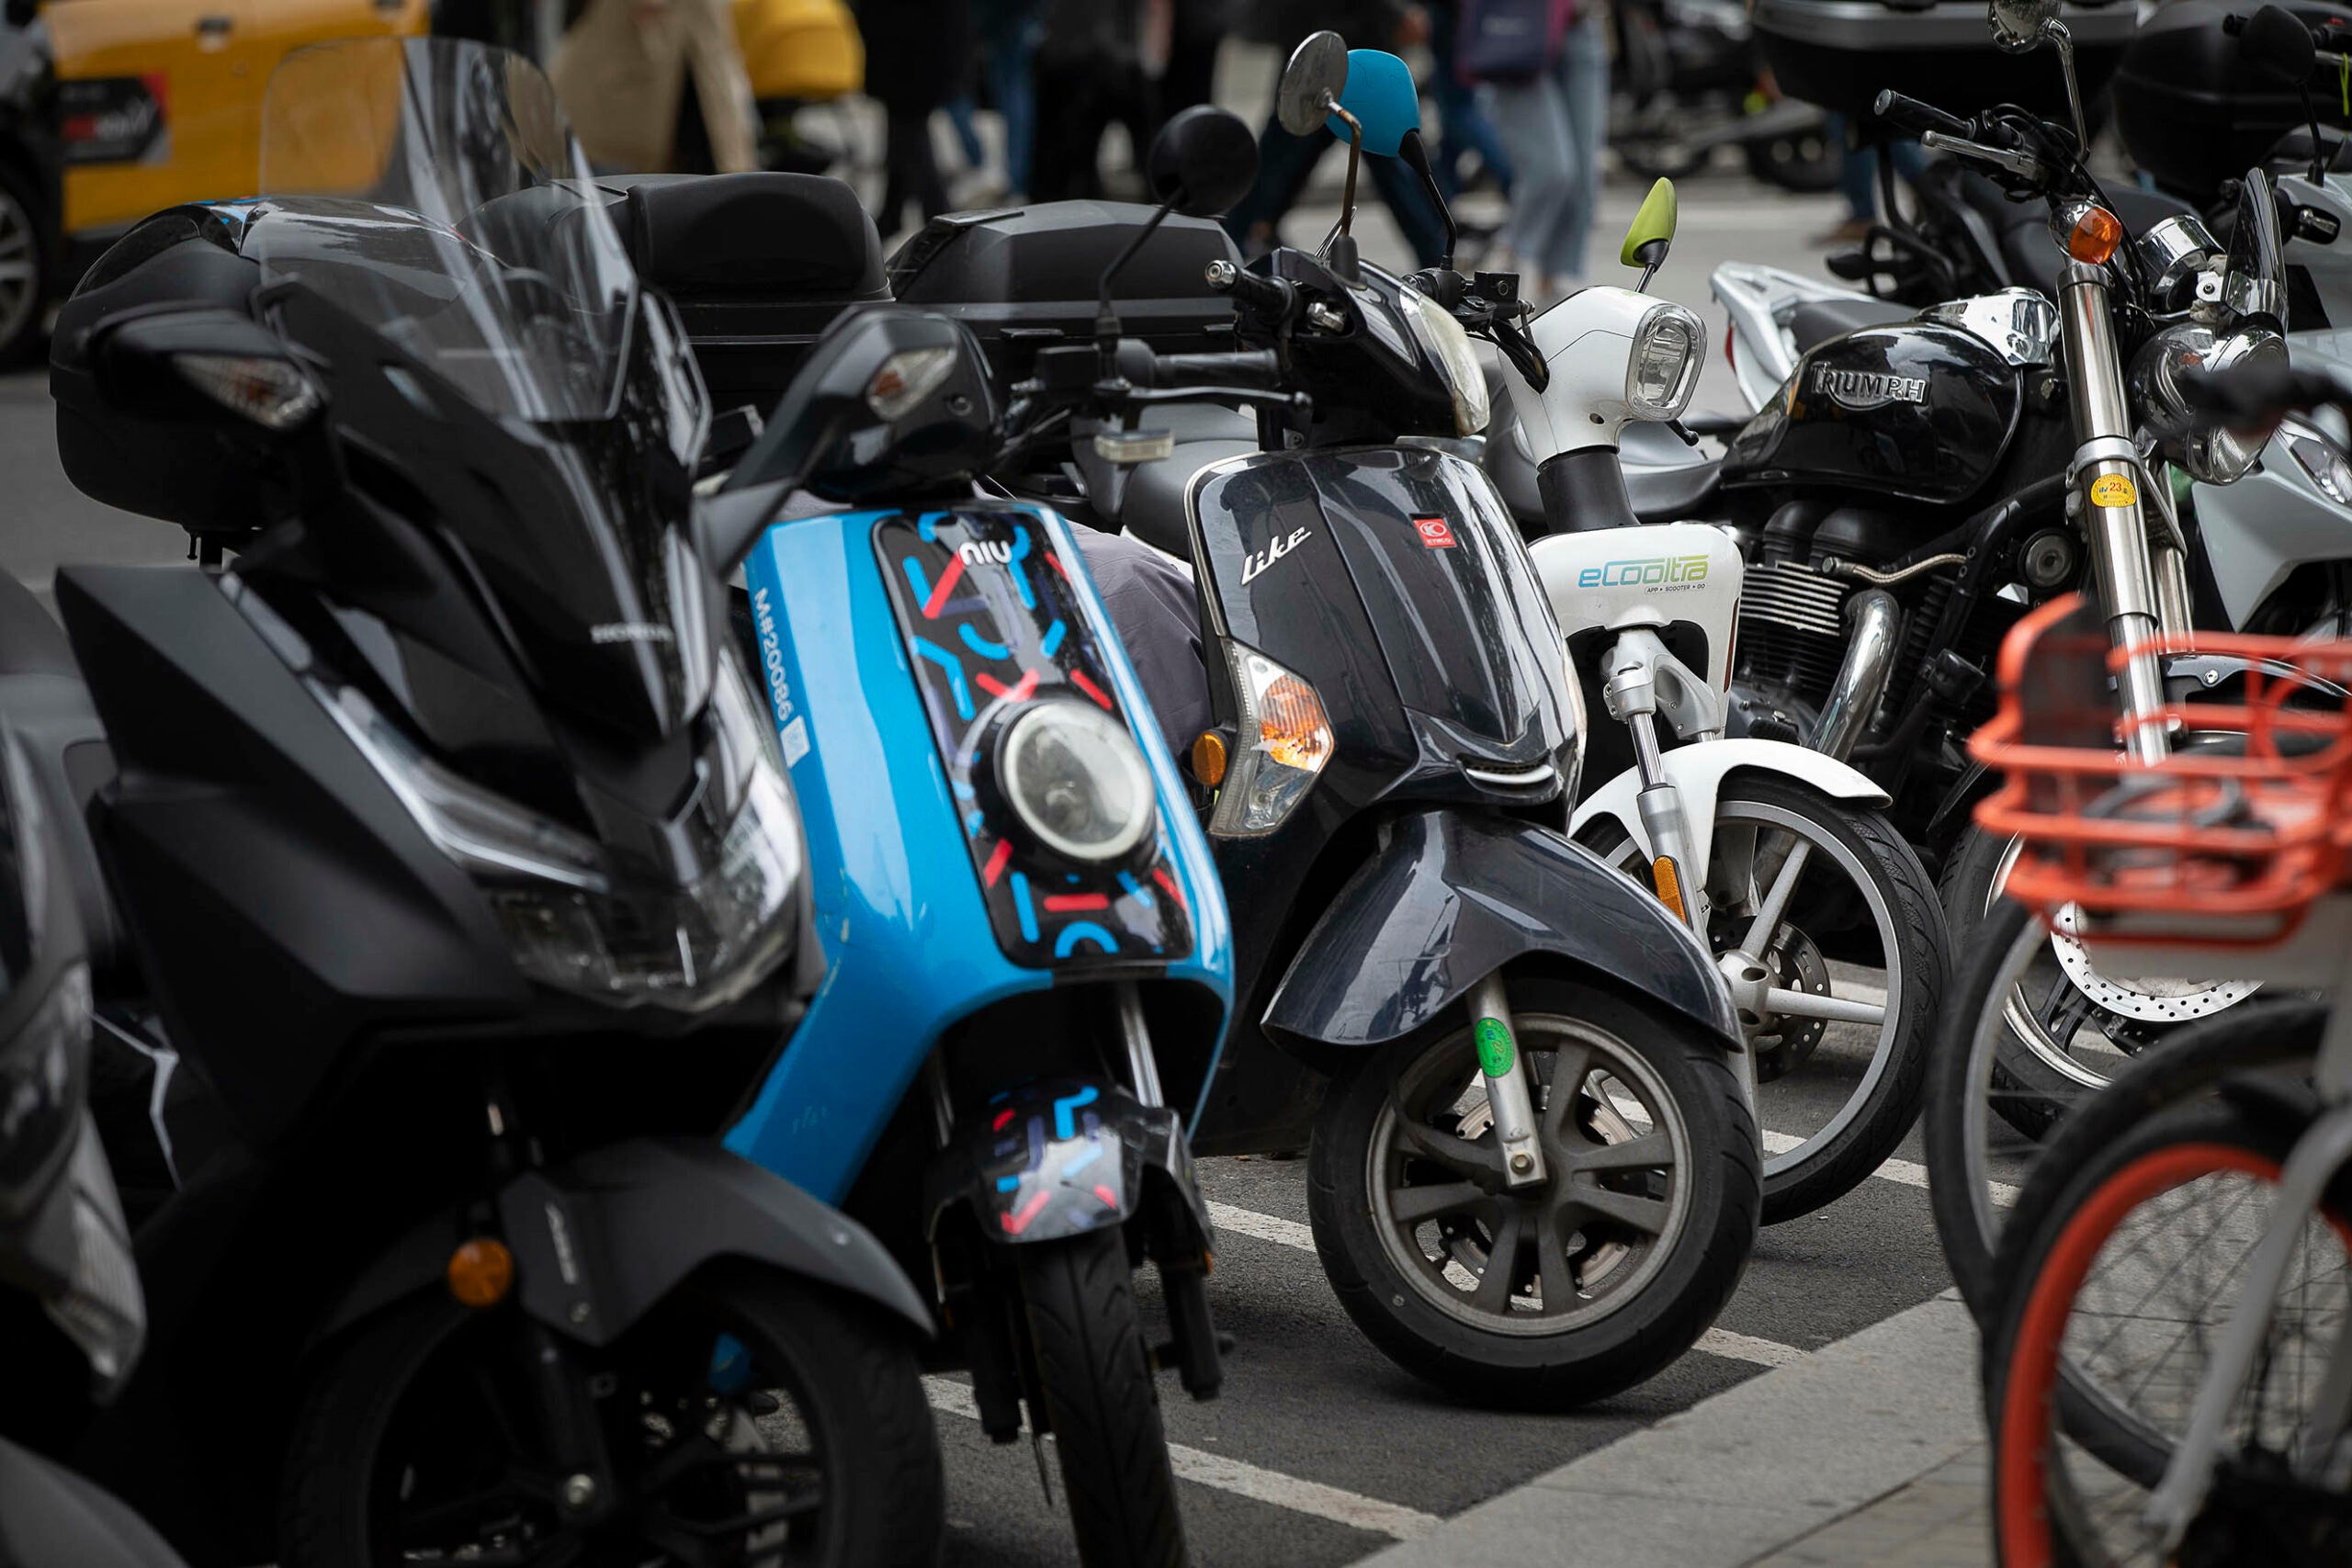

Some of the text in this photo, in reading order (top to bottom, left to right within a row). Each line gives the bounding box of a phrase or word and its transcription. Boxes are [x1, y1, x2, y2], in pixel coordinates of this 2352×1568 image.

[1812, 361, 1926, 403] TRIUMPH
[2109, 481, 2122, 492] 23
[1241, 526, 1312, 585] Like
[754, 587, 795, 722] M#20086
